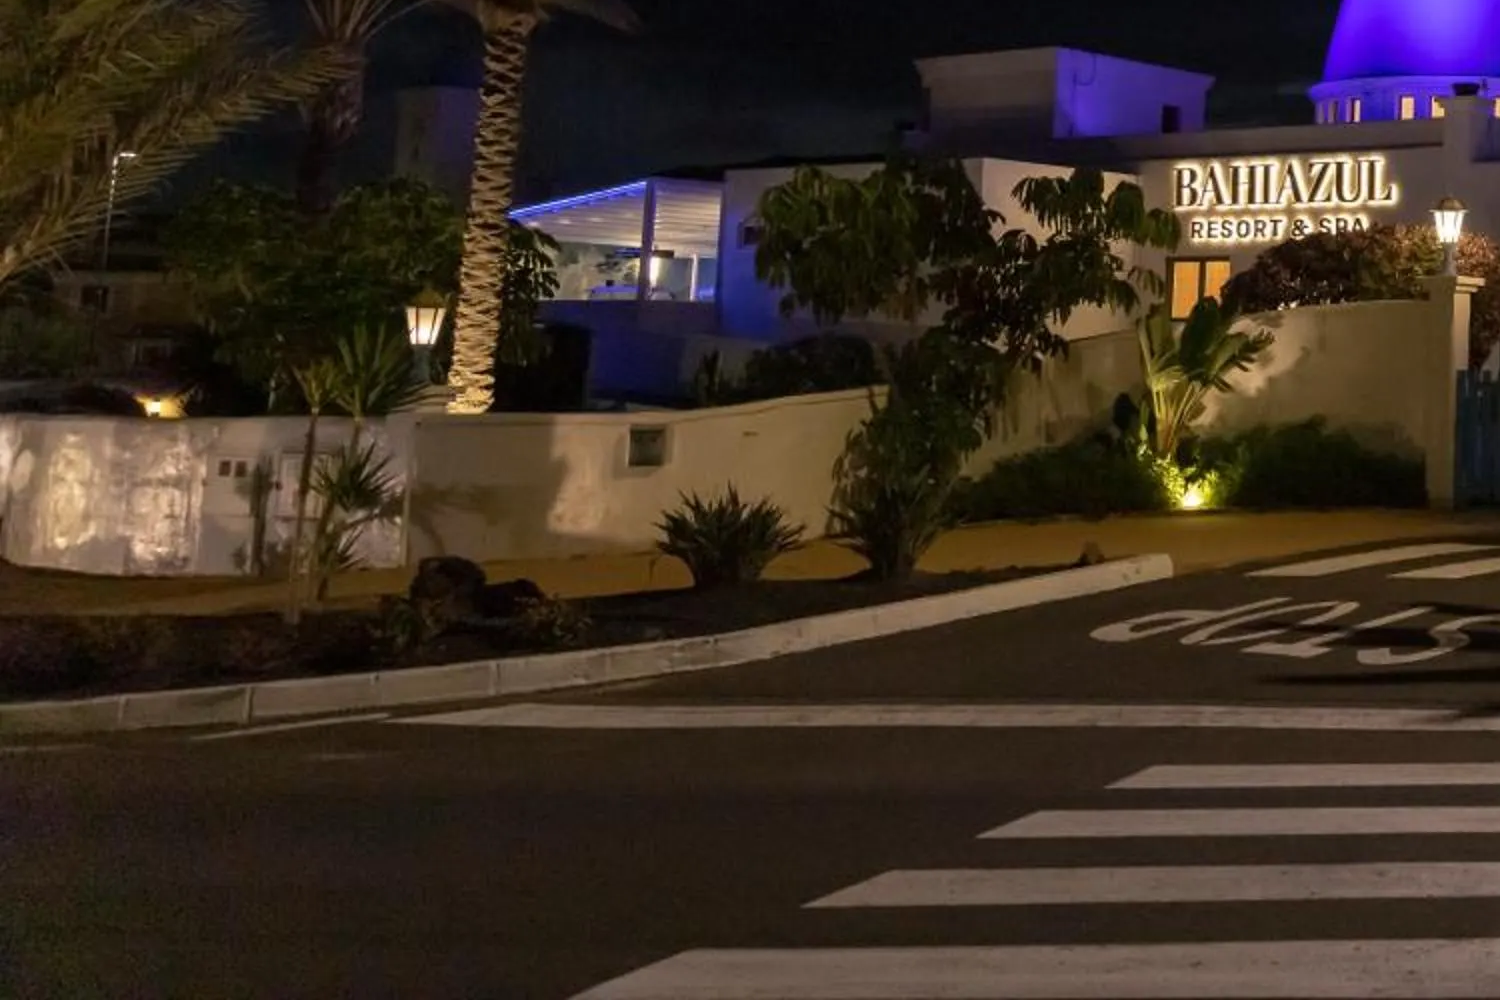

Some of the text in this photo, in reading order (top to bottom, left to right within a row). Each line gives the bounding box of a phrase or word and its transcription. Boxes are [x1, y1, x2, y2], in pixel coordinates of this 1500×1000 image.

[1173, 157, 1395, 207] BAHIAZUL
[1190, 216, 1366, 239] RESORT & SPA
